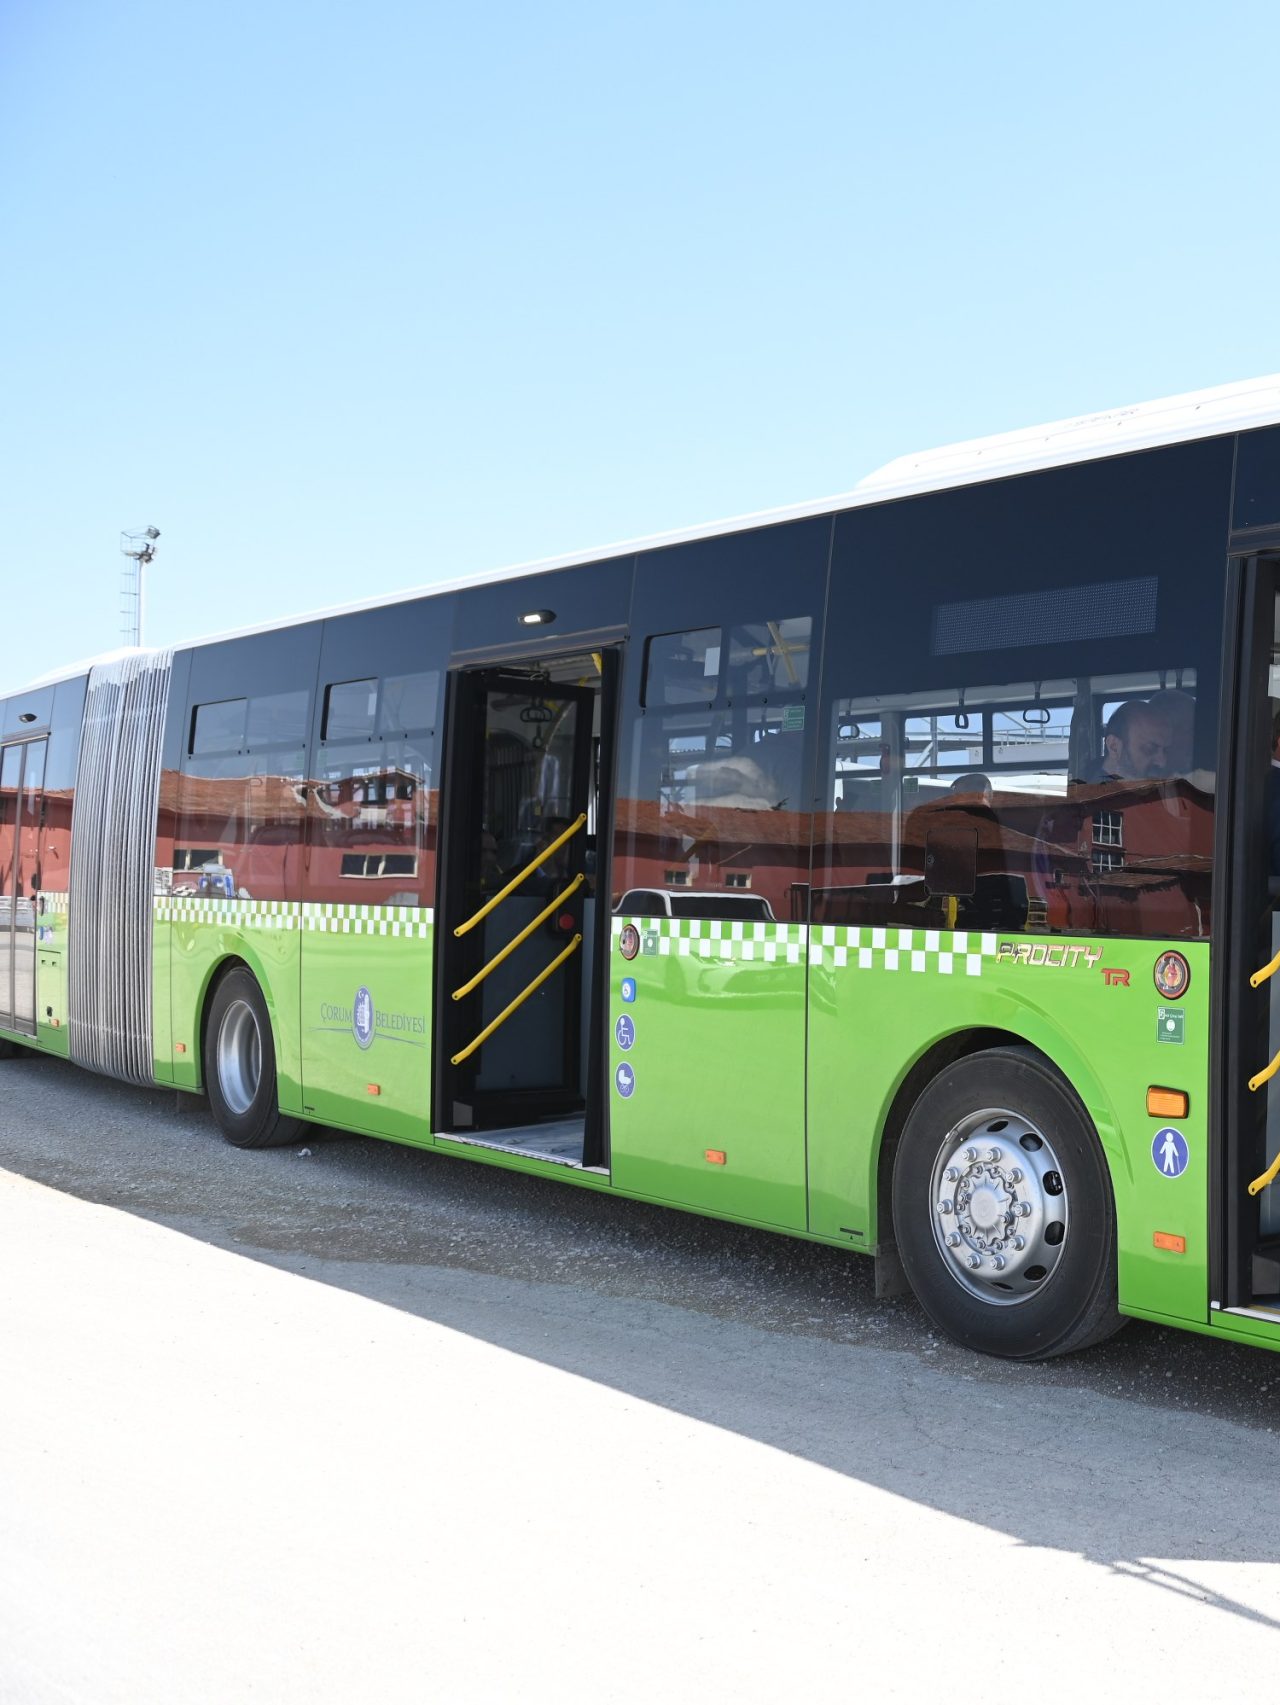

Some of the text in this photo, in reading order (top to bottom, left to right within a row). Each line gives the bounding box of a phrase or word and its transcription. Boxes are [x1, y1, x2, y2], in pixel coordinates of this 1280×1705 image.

[996, 942, 1104, 968] PROCITY
[1101, 968, 1130, 987] TR
[320, 1002, 425, 1034] ÇORUM BELEDİYESİ
